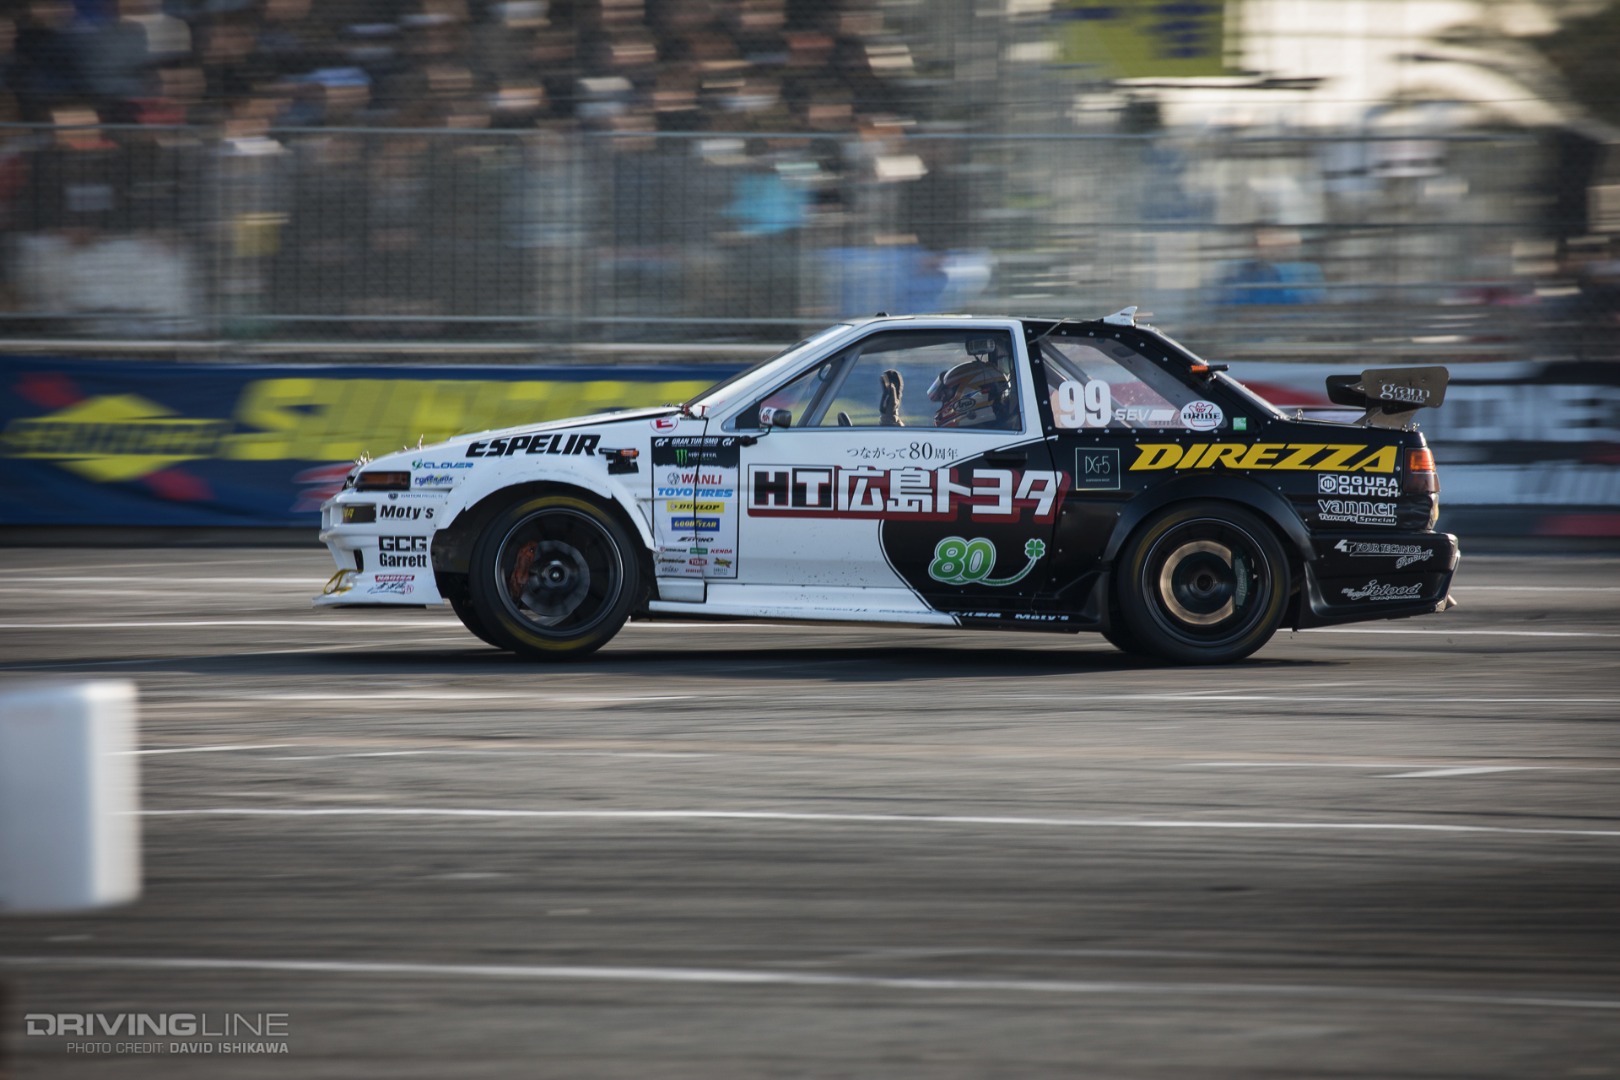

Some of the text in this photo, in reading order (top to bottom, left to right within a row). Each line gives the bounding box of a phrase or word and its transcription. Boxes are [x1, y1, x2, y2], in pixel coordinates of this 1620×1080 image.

[1380, 383, 1429, 400] gram
[1058, 379, 1111, 428] 99
[1183, 412, 1221, 420] BRIDE
[465, 434, 601, 457] ESPELIR
[847, 442, 959, 460] つながって80周年
[1129, 444, 1398, 473] DIREZZA
[681, 474, 722, 485] WANLI
[1339, 475, 1398, 487] OGURA
[657, 488, 733, 498] TOYO TIRES
[1339, 486, 1398, 497] CLUTCH
[379, 505, 434, 520] Moty's
[1318, 499, 1397, 516] vanner
[379, 536, 427, 552] GCG
[379, 553, 427, 567] Garrett
[928, 536, 997, 586] 80
